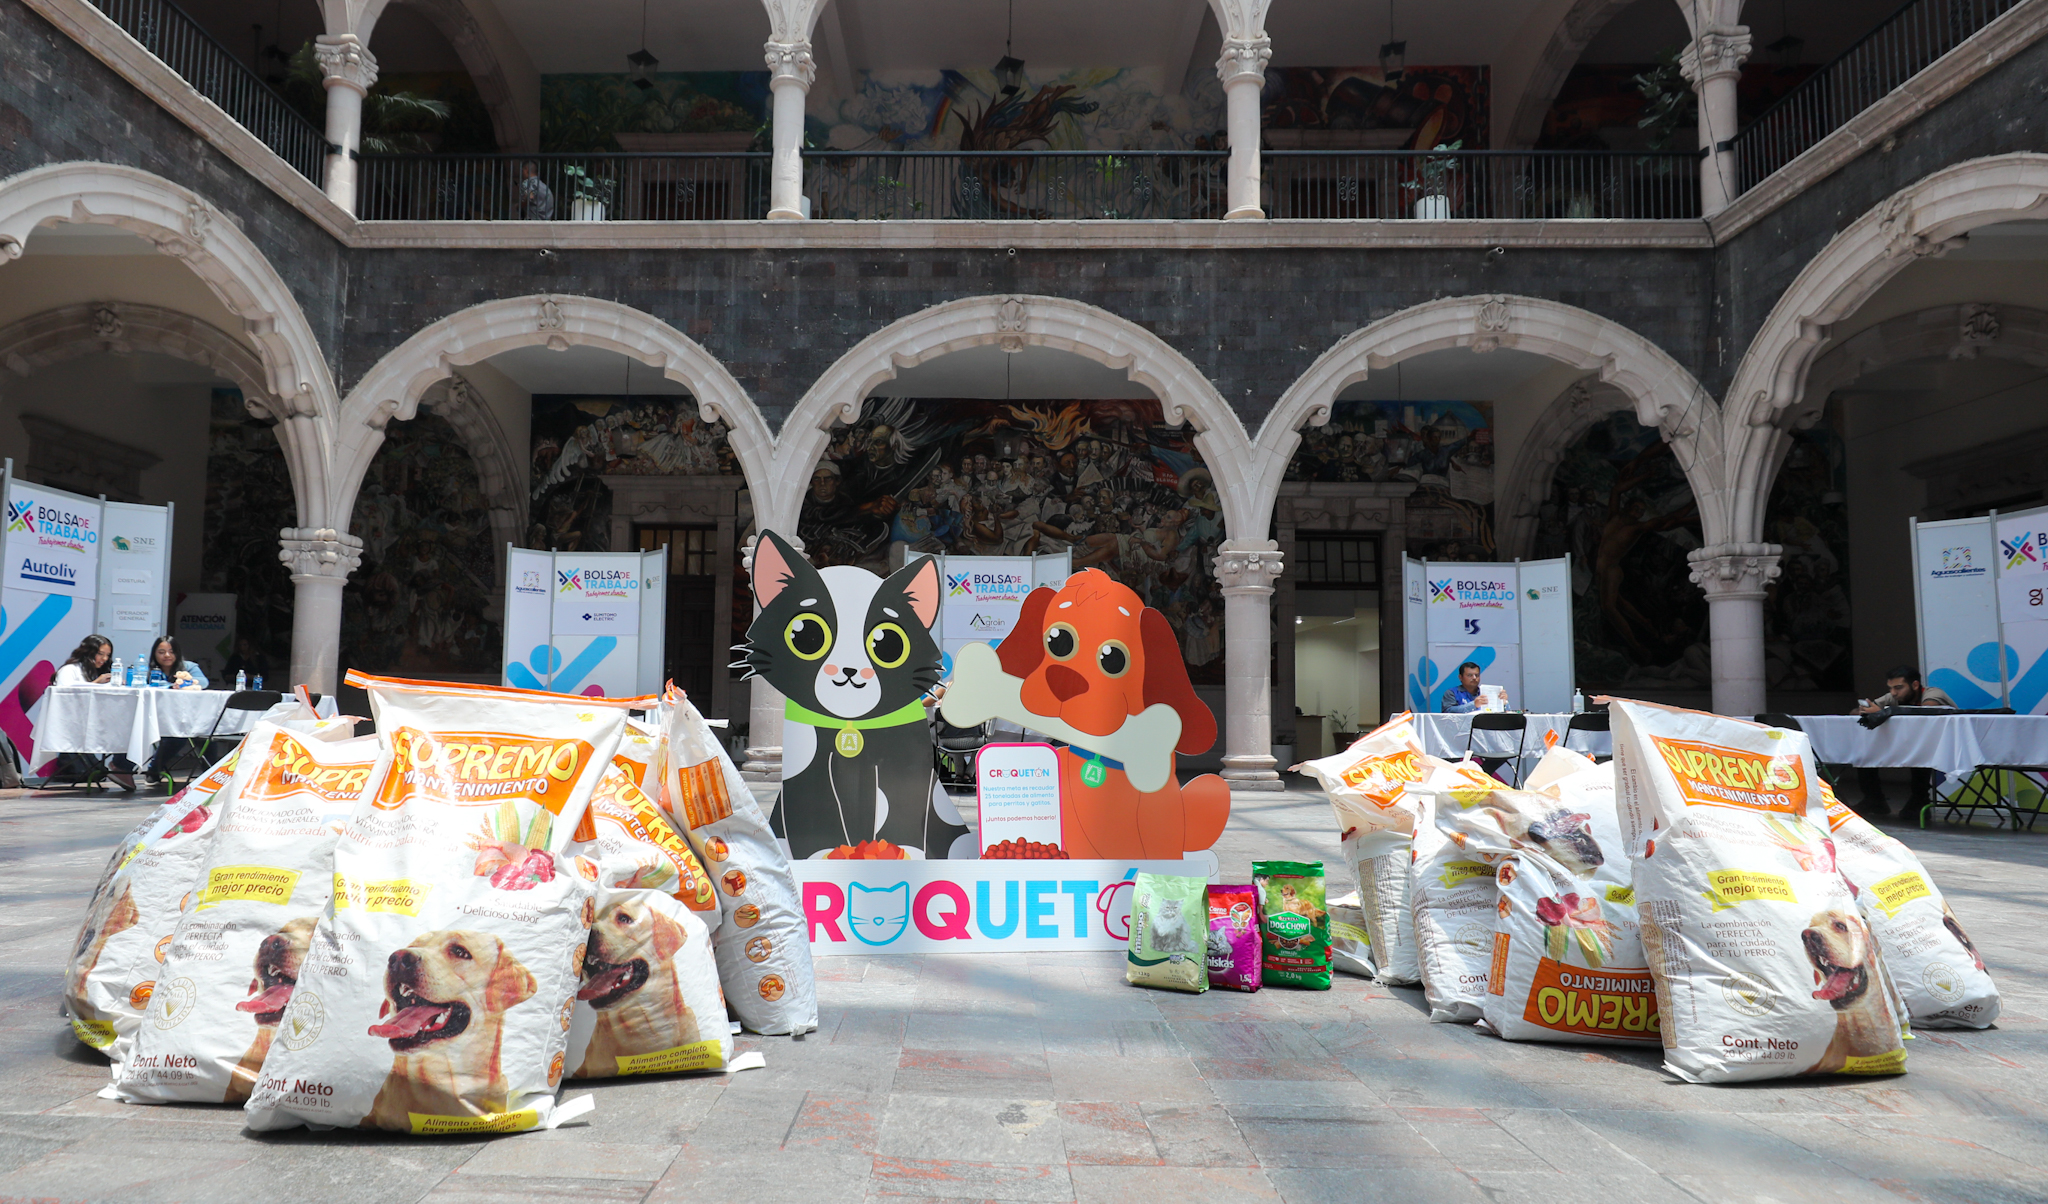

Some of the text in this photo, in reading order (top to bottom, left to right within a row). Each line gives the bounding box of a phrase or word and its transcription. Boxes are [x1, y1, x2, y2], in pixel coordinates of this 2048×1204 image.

[38, 506, 89, 529] BOLSA DE
[38, 520, 96, 544] TRABAJO
[133, 536, 156, 546] SNE
[22, 558, 76, 578] Autoliv
[584, 570, 630, 580] BOLSA DE
[974, 574, 1012, 584] BOLSA
[584, 580, 638, 590] TRABAJO
[974, 584, 1030, 594] TRABAJO
[1457, 581, 1496, 591] BOLSA
[1458, 590, 1514, 600] TRABAJO
[180, 614, 226, 623] ATENCIÓN
[396, 732, 578, 782] SUPREMO
[272, 738, 371, 791] SUPR
[1658, 741, 1800, 792] SUPREMO
[404, 770, 548, 797] MANTENIMIENTO
[1687, 779, 1791, 806] MANTENIMIENTO
[236, 805, 294, 817] ADICIONADO
[226, 813, 268, 824] VITAMINAS
[219, 823, 326, 836] Nutrición balanceada
[356, 816, 397, 836] VITAMINAS
[344, 826, 393, 849] Nutrición
[600, 776, 713, 904] SUPREMO
[214, 871, 289, 884] Gran rendimiento
[1717, 874, 1785, 886] Gran rendimiento
[212, 882, 284, 897] mejor precio
[336, 878, 420, 895] Gran rendimiento
[1722, 883, 1788, 896] mejor precio
[1878, 875, 1920, 895] Gran rendimiento
[1446, 885, 1488, 901] combinación
[1886, 883, 1925, 904] mejor precio
[372, 895, 414, 908] precio
[1448, 894, 1481, 907] PERFECTA
[463, 905, 539, 924] Delicioso Sabor
[189, 922, 236, 930] combinación
[1270, 921, 1307, 930] DOG CHOW
[1701, 919, 1772, 929] La combinación
[185, 932, 223, 940] PERFECTA
[1135, 912, 1144, 954] minino
[1716, 929, 1762, 938] PERFECTA
[1899, 926, 1925, 940] PERFECTA
[1706, 941, 1726, 949] para
[1740, 938, 1776, 947] cuidado
[1896, 941, 1912, 952] para
[1902, 950, 1914, 958] DE
[1923, 939, 1942, 951] PERRO
[194, 953, 223, 961] PERRO
[1711, 948, 1776, 958] DE TU PERRO
[1207, 958, 1234, 968] hiskas
[319, 965, 347, 977] PERRO
[1472, 985, 1484, 993] Kg
[1722, 1035, 1798, 1050] Cont. Neto
[133, 1054, 197, 1068] Cont. Neto
[629, 1046, 707, 1065] Alimento completo
[648, 1053, 709, 1068] mantenimiento
[1723, 1049, 1785, 1061] 20 Kg 44.09
[674, 1061, 704, 1070] adultos
[136, 1070, 183, 1082] Kg 44.09
[261, 1074, 334, 1097] Cont. Neto
[285, 1097, 317, 1106] 44.09
[425, 1118, 470, 1127] Alimento
[448, 1113, 522, 1132] mantenimiento
